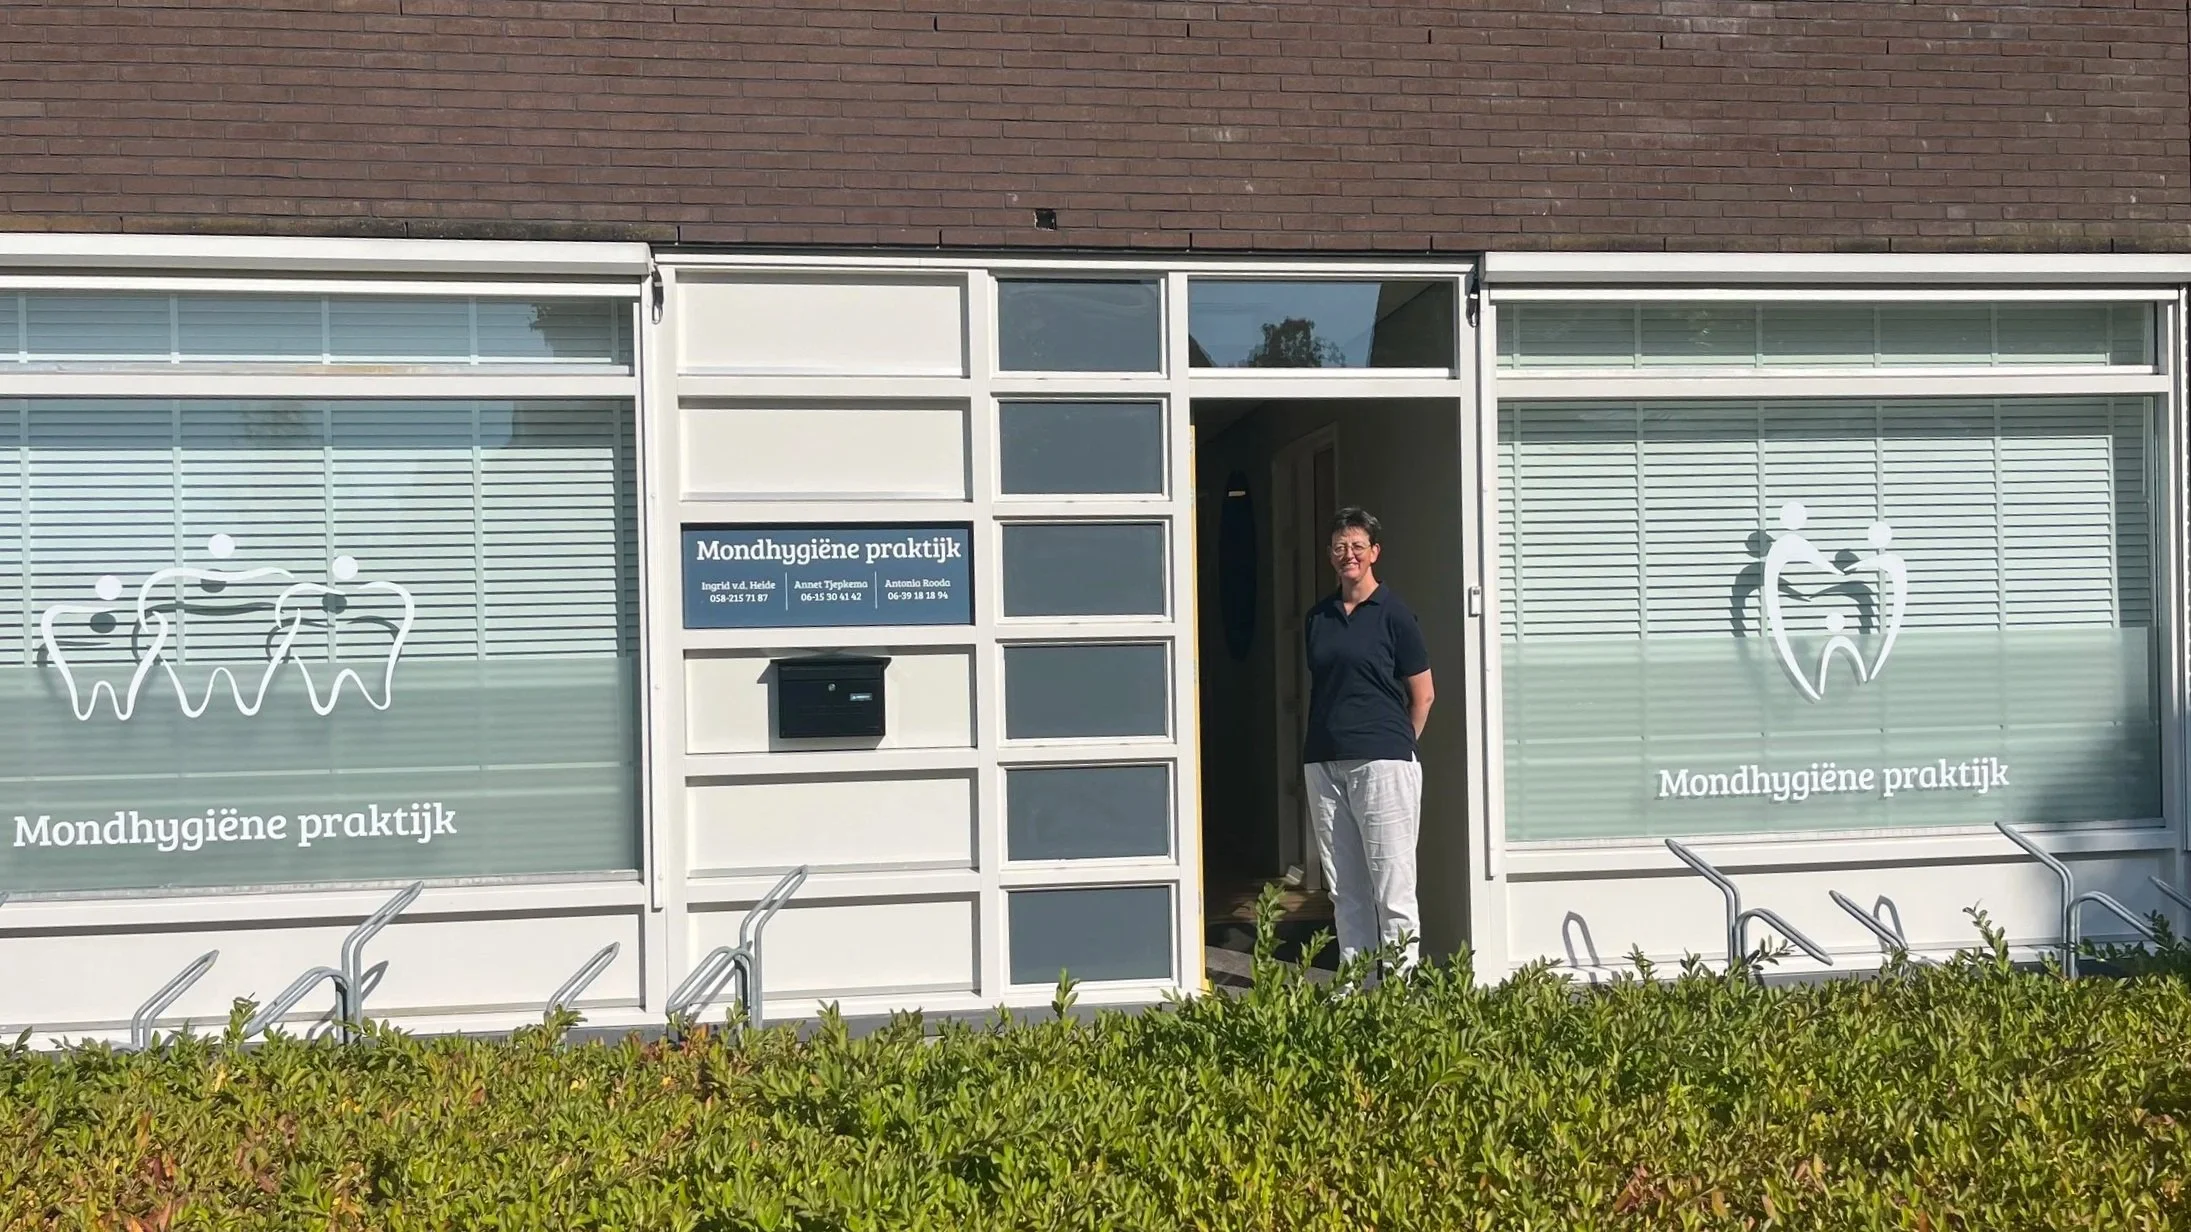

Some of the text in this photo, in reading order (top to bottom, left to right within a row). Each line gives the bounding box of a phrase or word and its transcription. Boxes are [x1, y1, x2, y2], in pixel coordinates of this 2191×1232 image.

[696, 537, 962, 565] Mondhygiëne praktijk
[701, 580, 776, 592] Ingrid v.d. Heide
[794, 579, 868, 591] Annet Tjepkema
[922, 578, 951, 588] Rooda
[709, 593, 769, 603] 058-215 71 87
[800, 592, 862, 602] 06-15 30 41 42
[887, 591, 949, 601] 06-39 18 18 94
[1658, 757, 2010, 801] Mondhygiëne praktijk
[13, 802, 458, 851] Mondhygiëne praktijk
